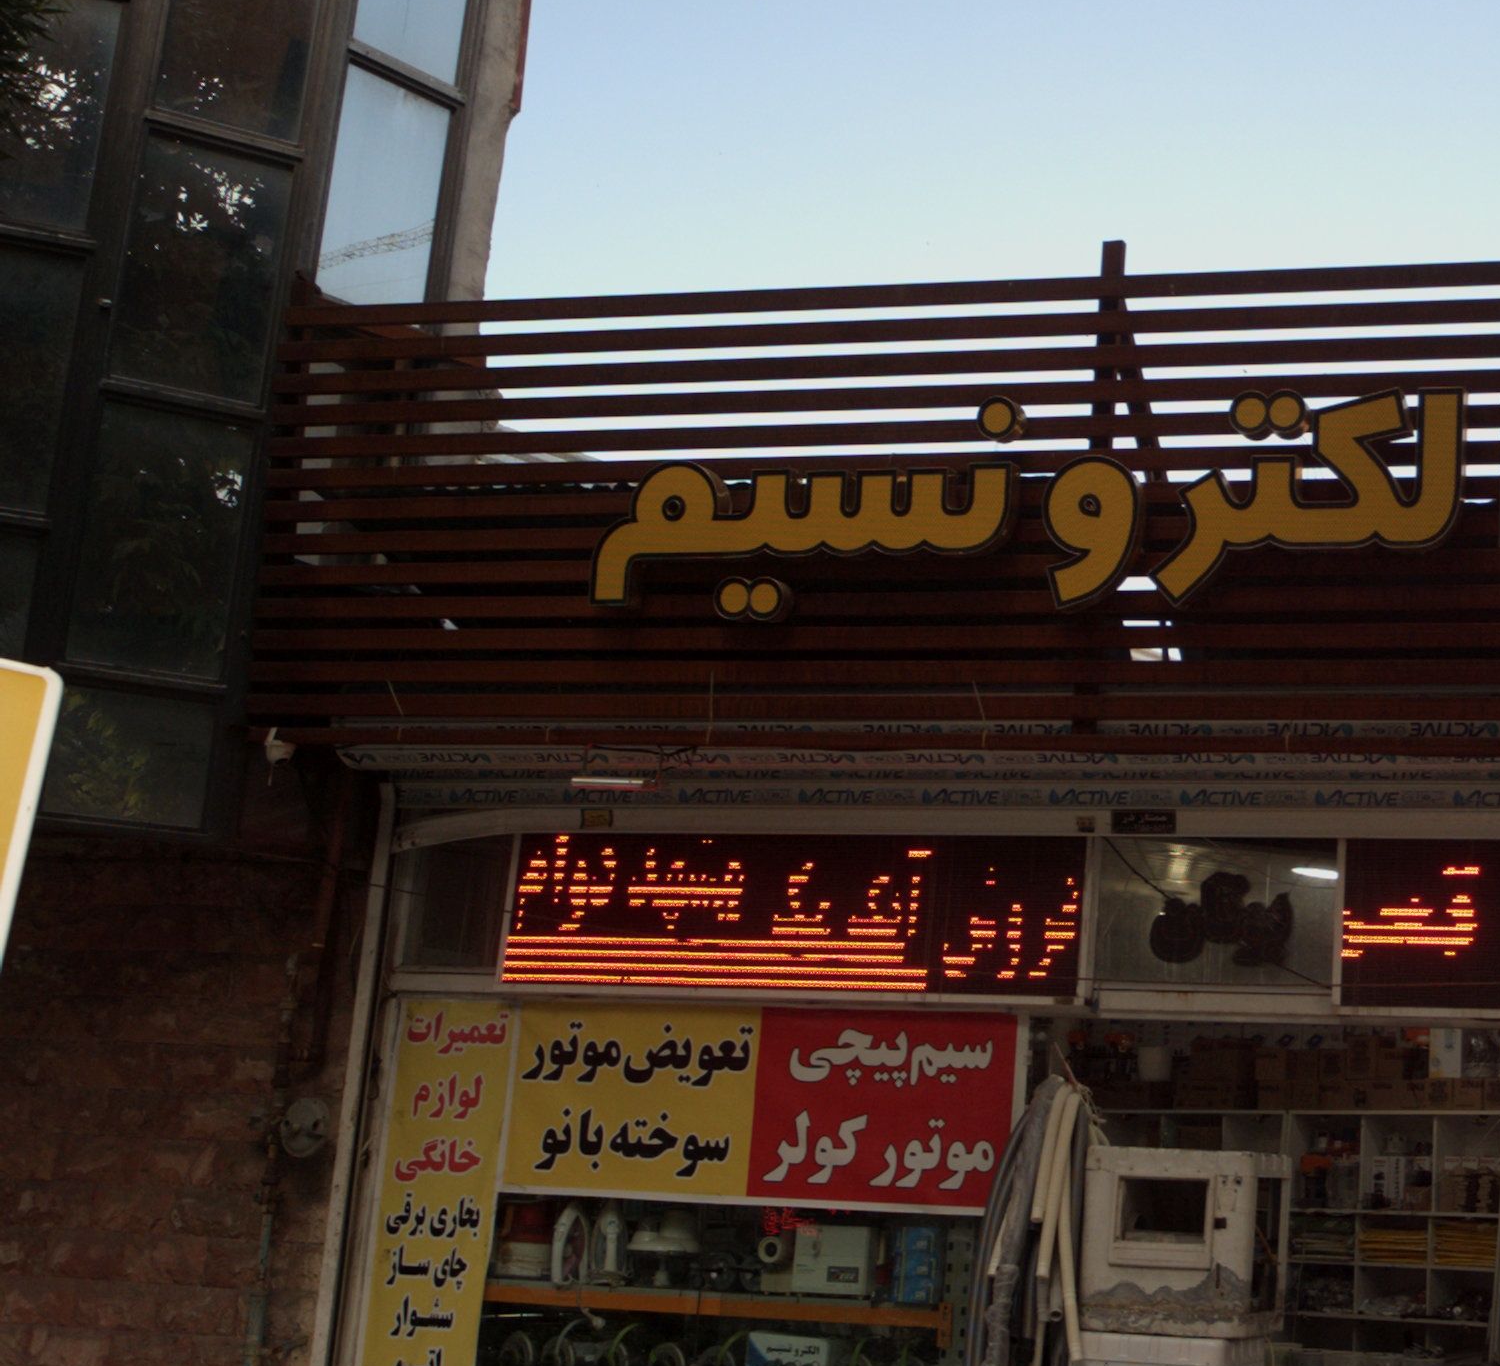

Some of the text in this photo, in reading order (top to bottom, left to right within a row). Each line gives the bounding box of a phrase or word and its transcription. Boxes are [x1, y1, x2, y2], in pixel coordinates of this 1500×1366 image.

[588, 393, 1026, 623] نسیم
[457, 788, 519, 804] ACTIVE
[572, 789, 632, 804] ACTIVE
[688, 788, 751, 804] ACTIVE
[809, 788, 874, 804] ACTIVE
[929, 788, 998, 805] ACTIVE
[1058, 788, 1129, 805] ACTIVE
[1188, 788, 1262, 806] ACTIVE
[1323, 789, 1400, 806] ACTIVE
[406, 1012, 508, 1054] تعمیرات
[523, 1021, 754, 1087] تعویض موتور
[412, 1074, 483, 1119] لوازم
[394, 1137, 481, 1183] خانگی
[609, 1112, 729, 1177] سوخته
[762, 1109, 995, 1190] موتور کولر
[386, 1192, 480, 1239] بخاری برقی
[387, 1243, 467, 1290] چای ساز
